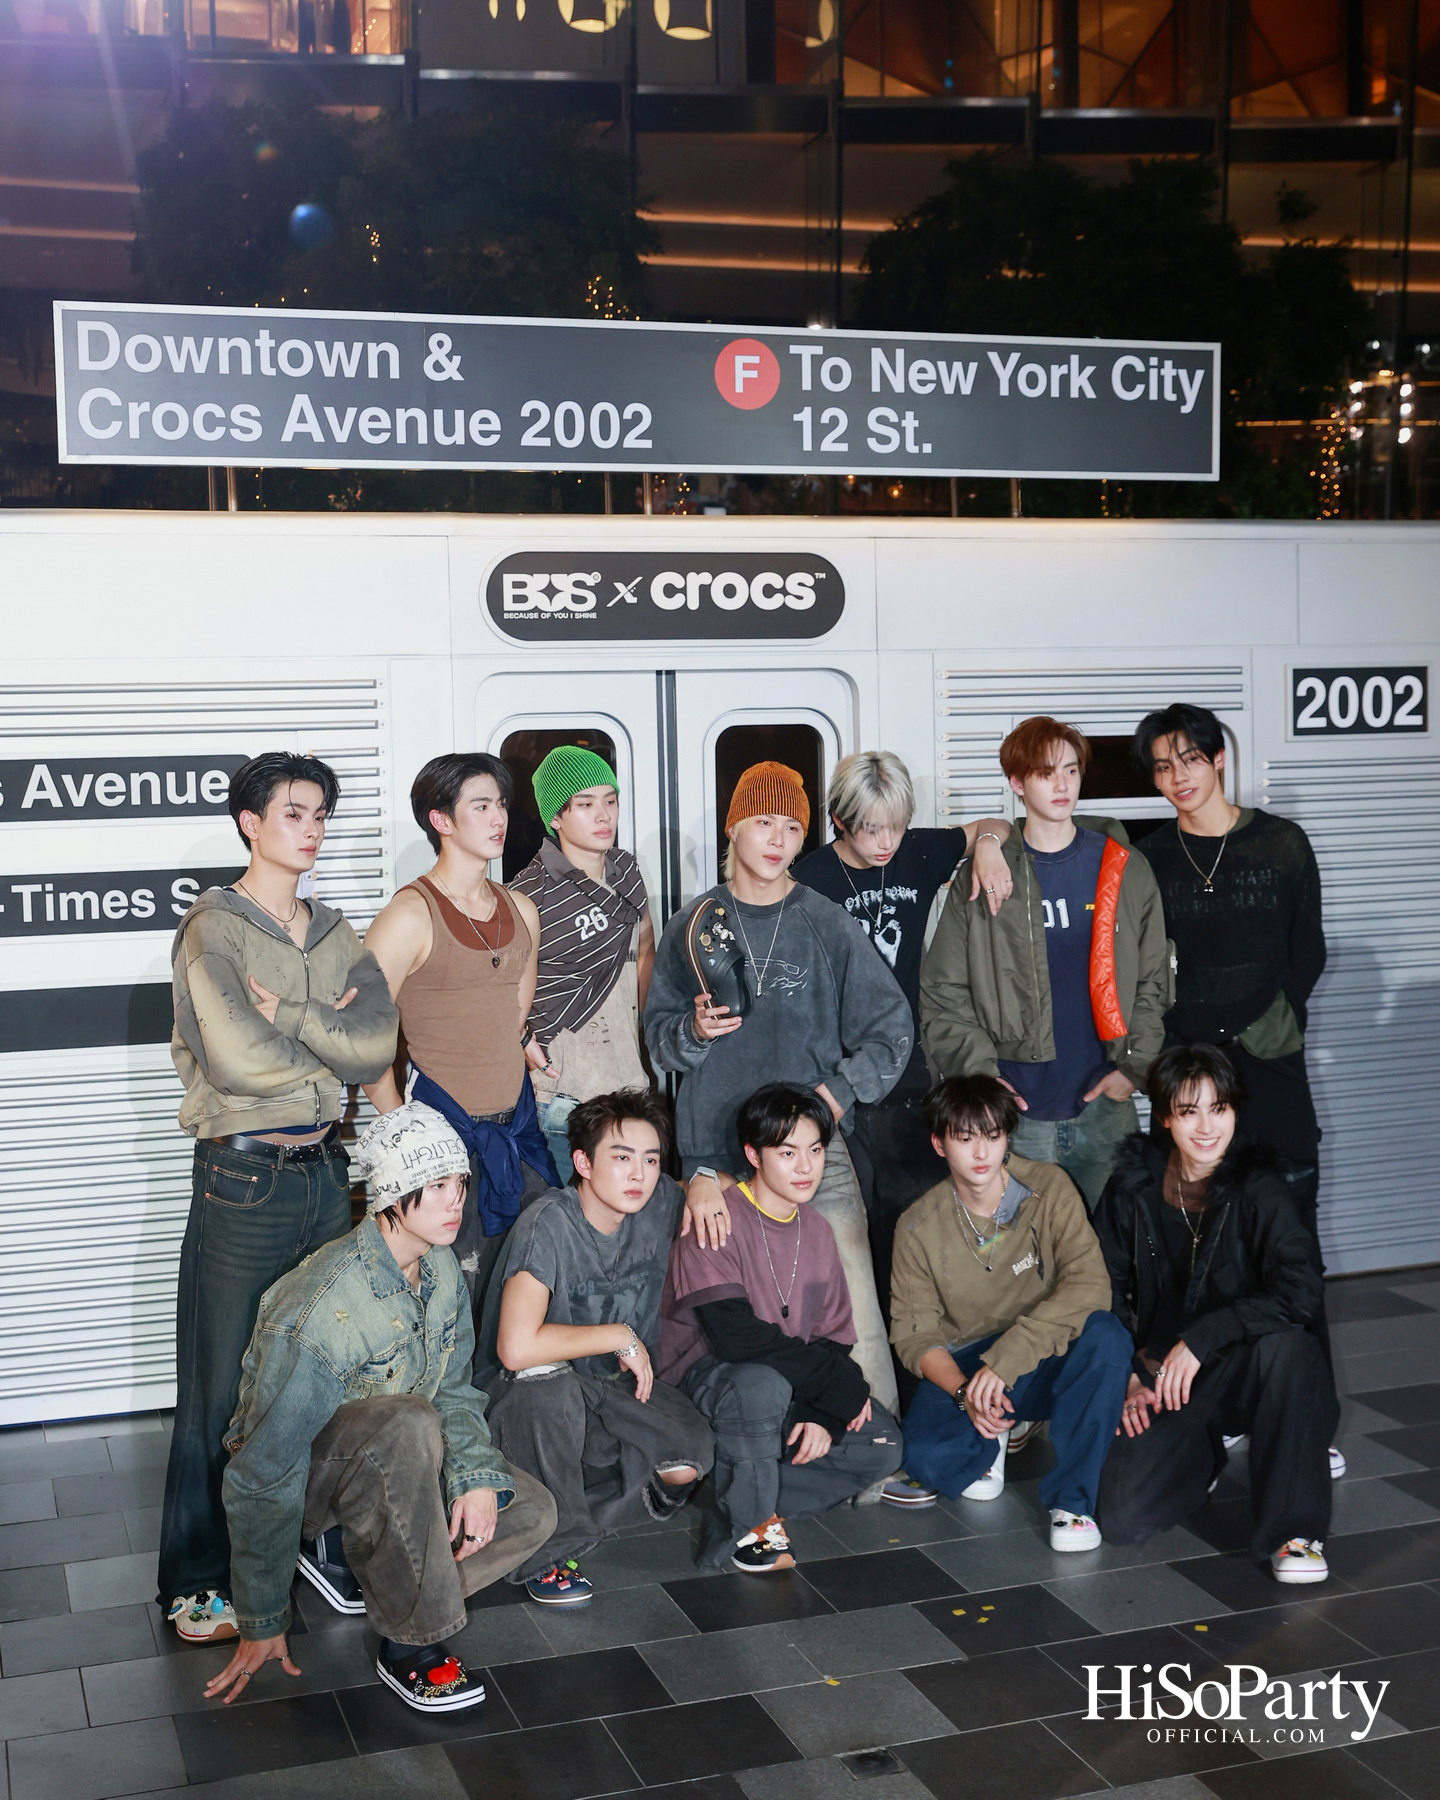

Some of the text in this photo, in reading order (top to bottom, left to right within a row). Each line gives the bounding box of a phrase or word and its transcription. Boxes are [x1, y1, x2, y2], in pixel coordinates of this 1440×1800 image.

[77, 320, 465, 382] Downtown &
[735, 355, 760, 393] F
[789, 344, 1205, 414] To New York City
[78, 387, 653, 449] Crocs Avenue 2002
[793, 406, 932, 454] 12 St.
[503, 612, 539, 620] BECAUSE
[574, 612, 598, 620] SHINE
[1296, 674, 1424, 729] 2002
[21, 763, 230, 809] Avenue
[574, 906, 609, 941] 26
